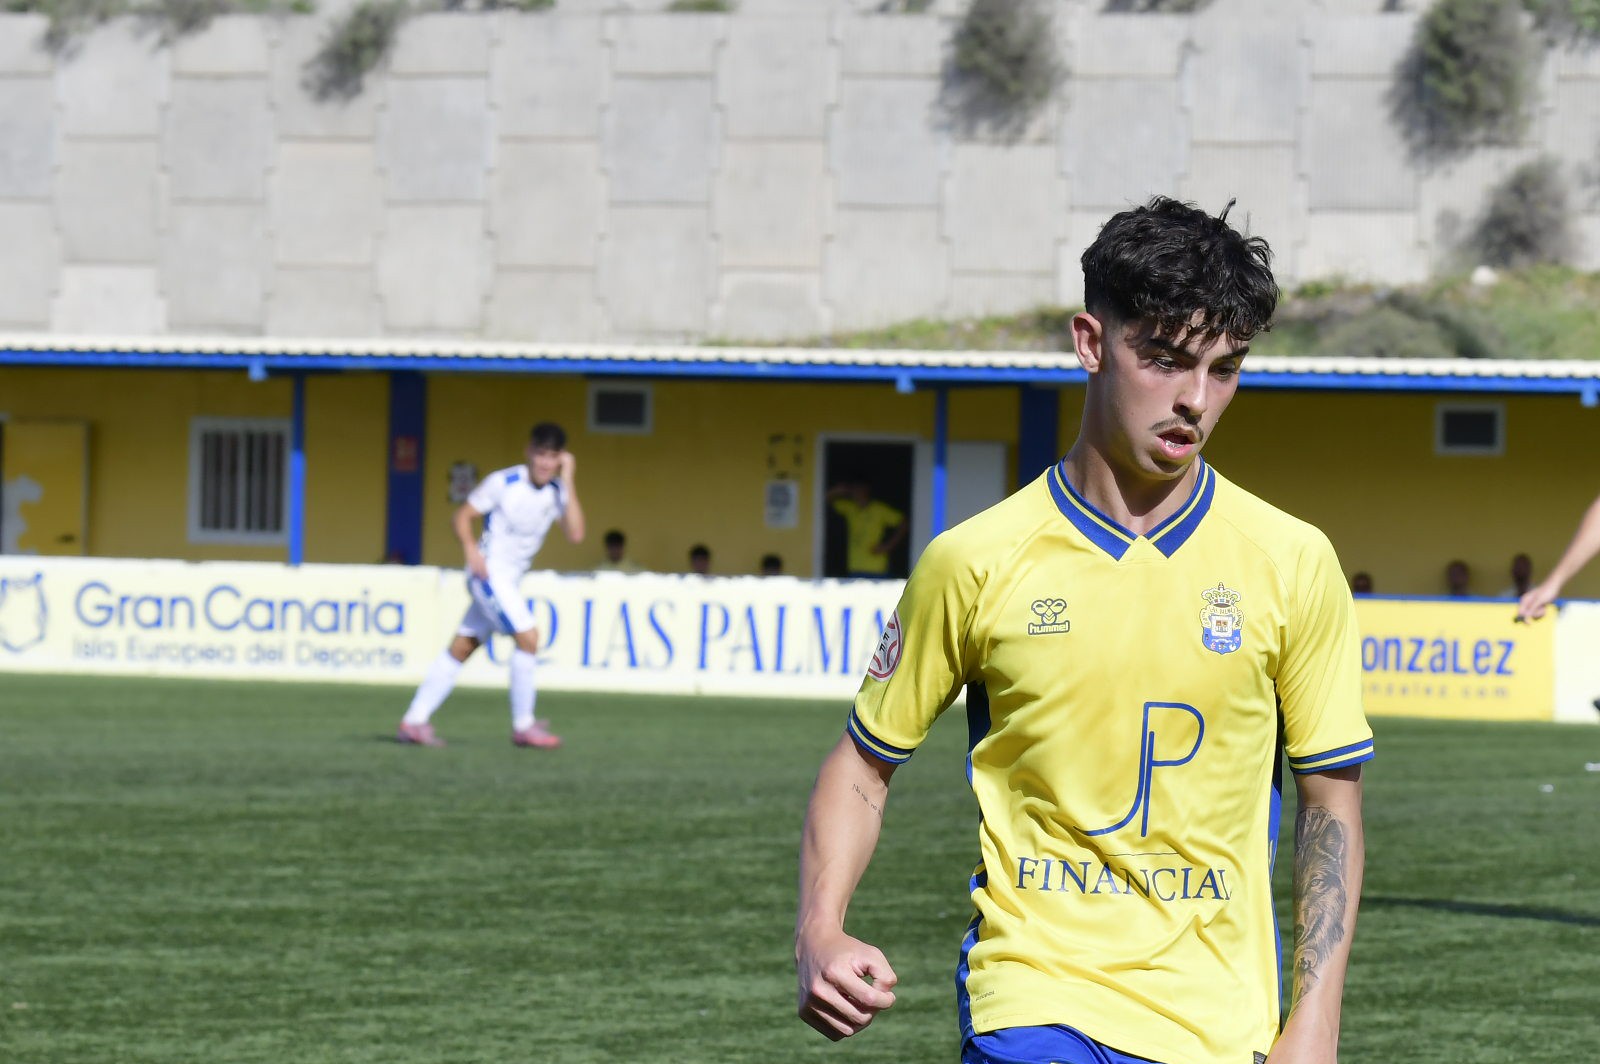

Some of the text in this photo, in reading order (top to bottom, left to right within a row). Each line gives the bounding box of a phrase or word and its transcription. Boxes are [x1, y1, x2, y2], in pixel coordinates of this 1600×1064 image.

[74, 581, 406, 635] Gran Canaria
[1028, 620, 1070, 635] hummel
[72, 637, 405, 671] Isla Europea del Deporte
[582, 598, 676, 669] LAS
